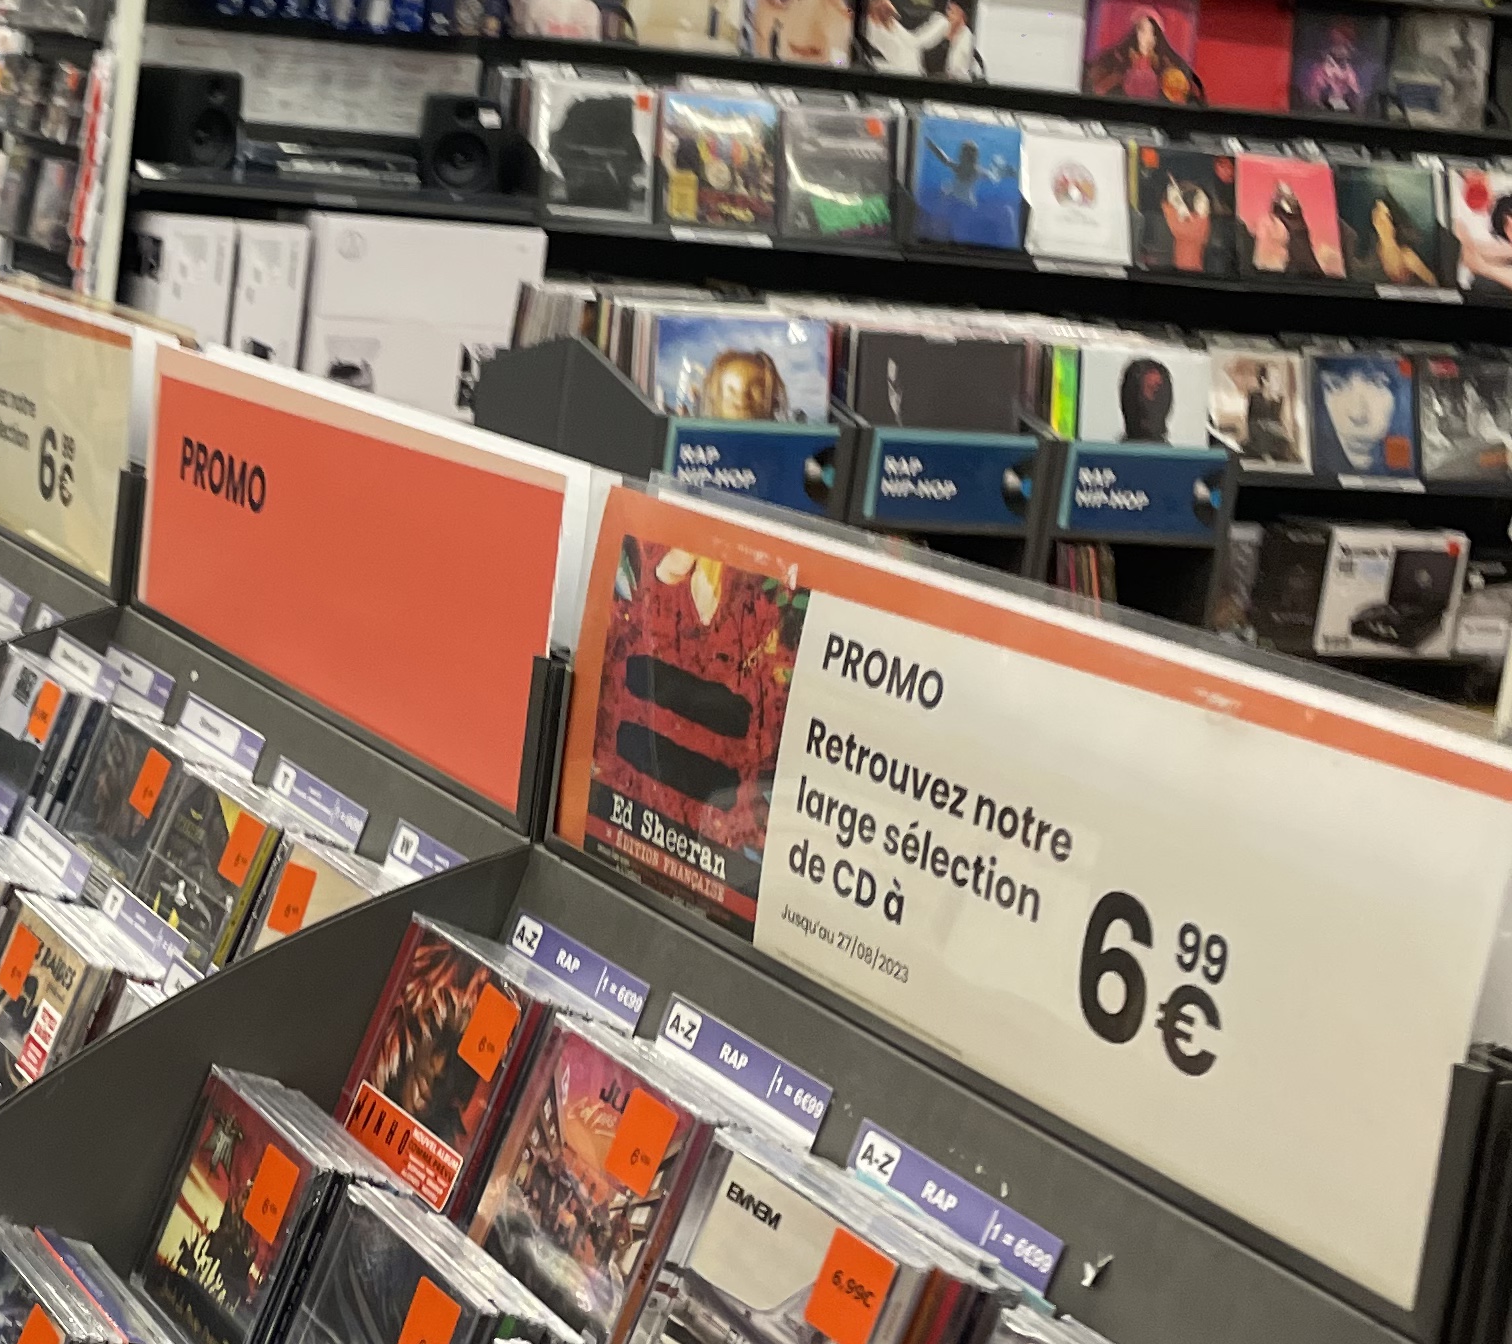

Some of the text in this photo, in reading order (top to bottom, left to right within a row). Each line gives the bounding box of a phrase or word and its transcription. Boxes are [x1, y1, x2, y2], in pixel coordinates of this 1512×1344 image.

[39, 425, 59, 503] 6
[179, 435, 267, 514] PROMO
[677, 465, 758, 490] HIP-HOP
[679, 443, 721, 465] RAP
[881, 476, 959, 501] HIP-HOP
[883, 455, 924, 478] RAP
[1077, 466, 1118, 489] RAP
[1075, 487, 1151, 512] HIP-HOP
[822, 632, 944, 711] PROMO
[806, 716, 1073, 863] Retrouvez notre
[609, 792, 633, 832] Ed
[640, 808, 727, 881] Sheeran
[615, 827, 660, 868] ÉDITION
[663, 856, 726, 904] FRANÇAISE
[796, 775, 1041, 924] large sélection
[788, 838, 905, 925] de CD à
[515, 924, 539, 951] A-Z
[556, 948, 581, 974] RAP
[781, 903, 910, 984] Jusqu'au 27/08/2023
[1079, 890, 1229, 1077] 6 99 €
[669, 1012, 698, 1044] A-Z
[719, 1042, 749, 1072] RAP
[346, 1092, 411, 1156] NINHO
[860, 1143, 895, 1176] A-Z
[921, 1179, 959, 1212] RAP
